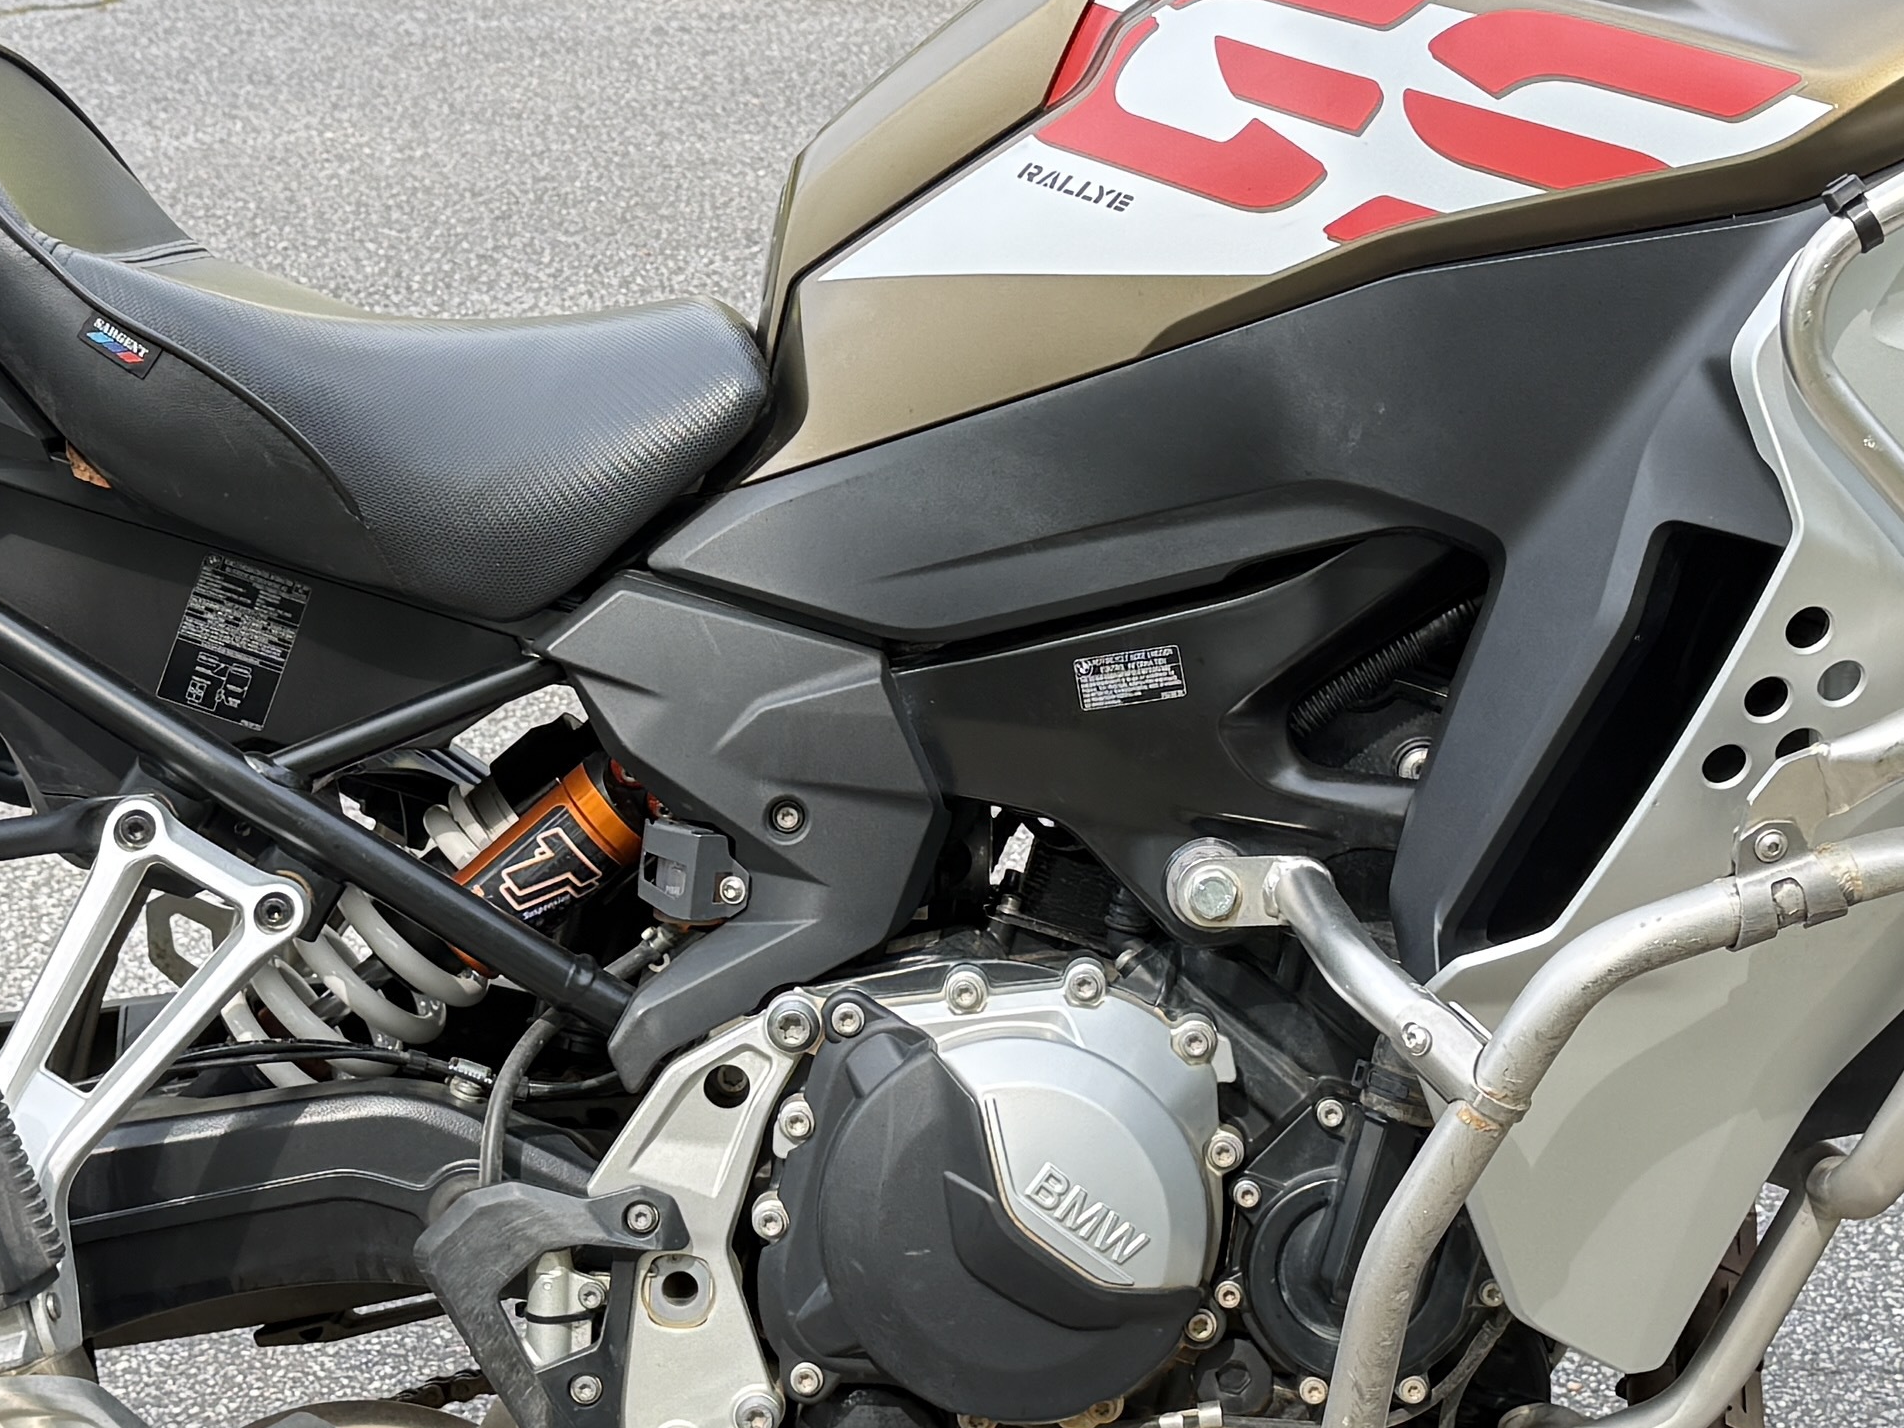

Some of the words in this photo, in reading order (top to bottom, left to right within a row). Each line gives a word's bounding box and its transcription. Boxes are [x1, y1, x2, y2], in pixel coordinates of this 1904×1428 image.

[1017, 161, 1135, 213] RALLYE
[93, 317, 149, 358] SARGENT
[1022, 1160, 1152, 1264] BMW
